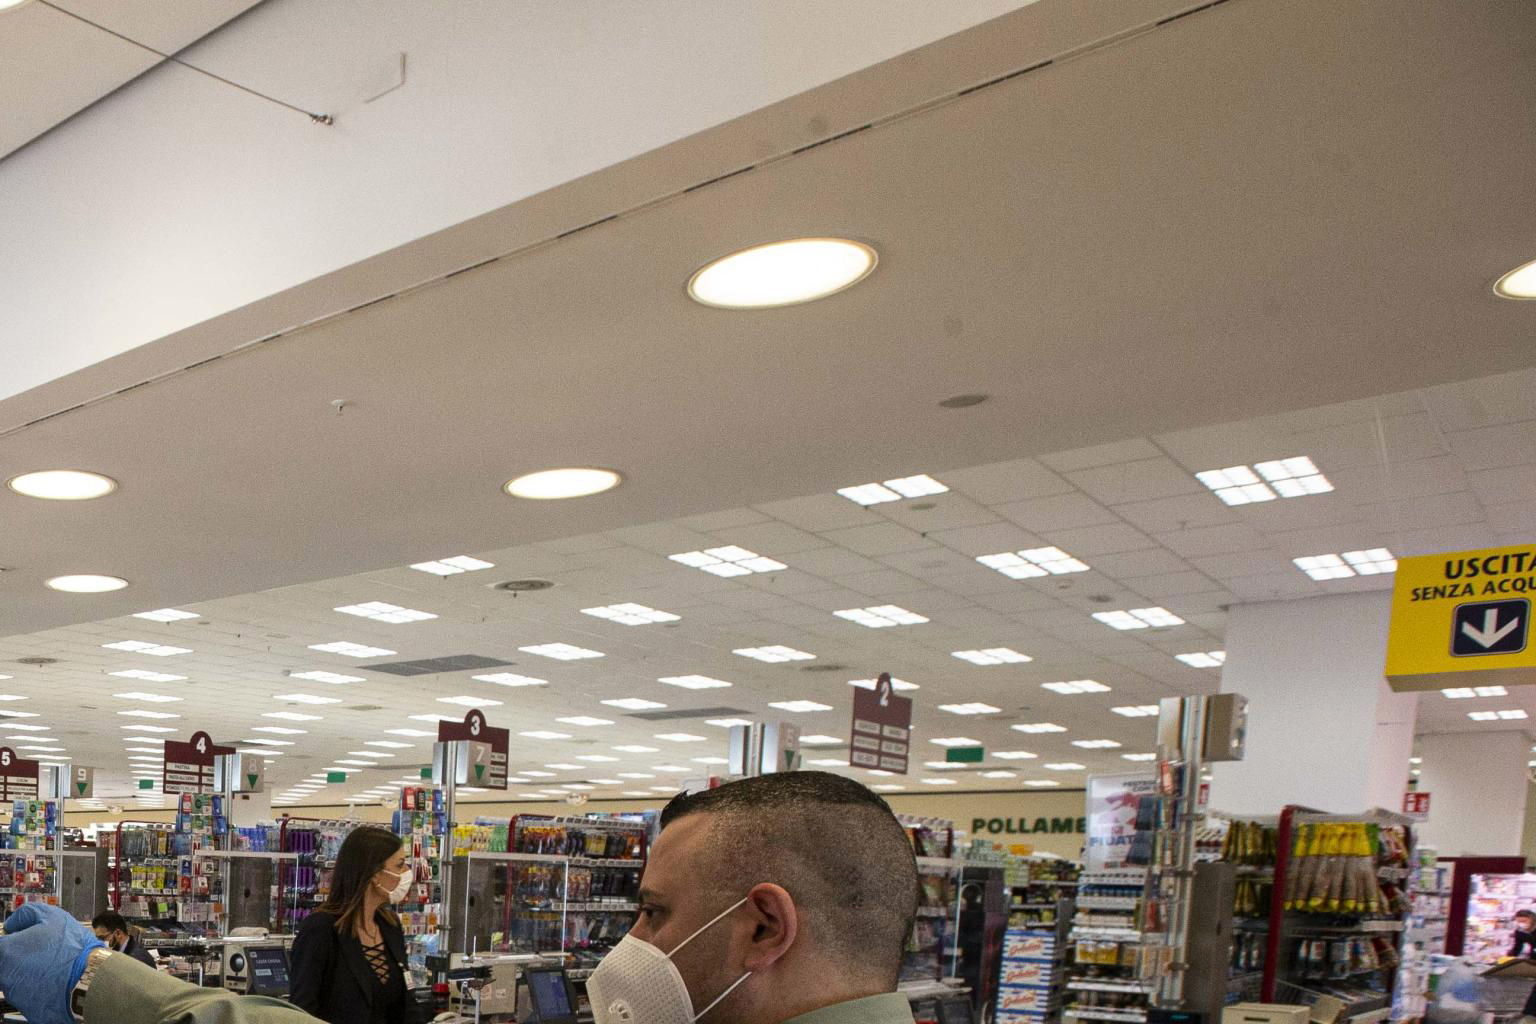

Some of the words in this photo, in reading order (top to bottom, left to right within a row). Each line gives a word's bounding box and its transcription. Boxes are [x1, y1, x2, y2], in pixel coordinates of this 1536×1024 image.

[1411, 582, 1475, 602] SENZA
[880, 681, 889, 707] 2
[470, 715, 481, 736] 3
[196, 736, 206, 754] 4
[476, 745, 485, 762] 7
[1, 751, 11, 766] 5
[971, 817, 1086, 834] POLLAME
